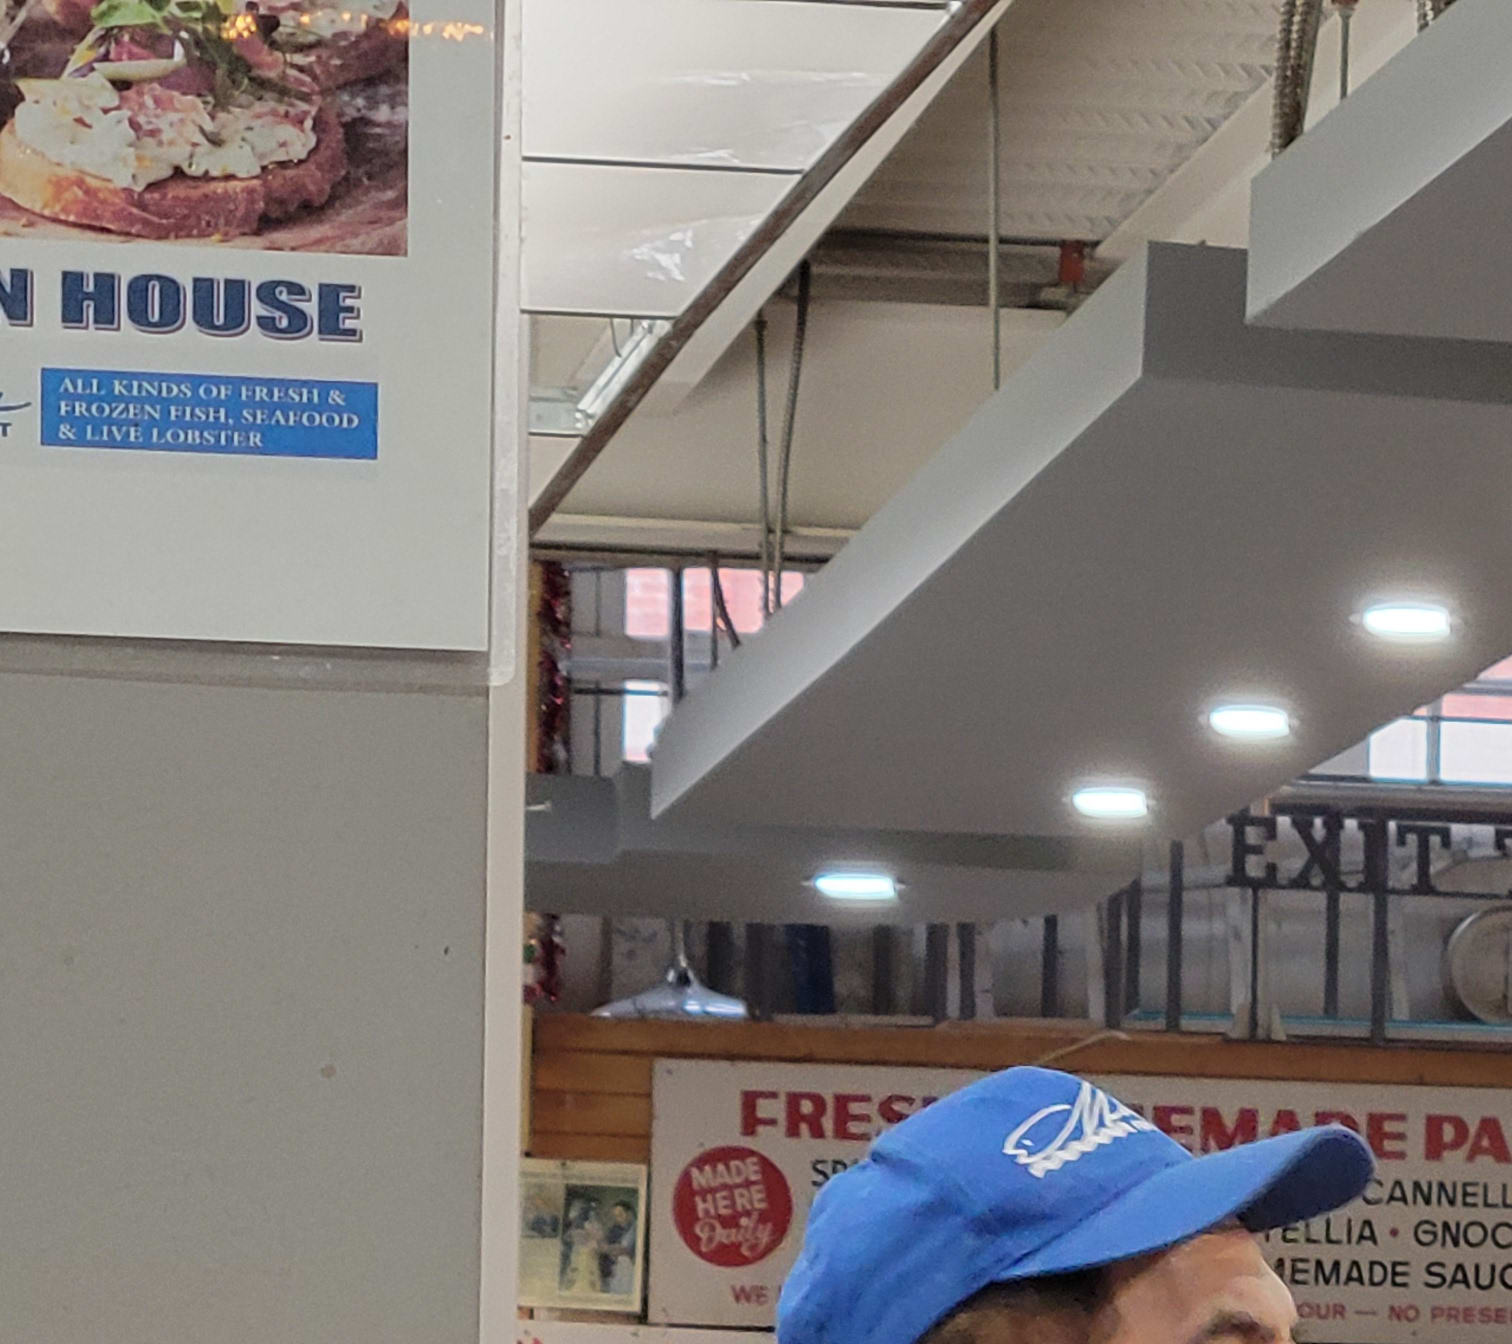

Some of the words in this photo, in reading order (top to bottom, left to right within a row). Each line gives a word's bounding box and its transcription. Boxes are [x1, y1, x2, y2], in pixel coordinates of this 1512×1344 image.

[61, 270, 363, 343] HOUSE
[59, 376, 104, 395] ALL
[113, 379, 192, 399] KINDS
[199, 383, 232, 401] OF
[240, 385, 319, 405] FRESH
[328, 388, 346, 407] &
[59, 401, 161, 421] FROZEN
[169, 406, 234, 426] FISH,
[241, 408, 359, 430] SEAFOOD
[58, 422, 77, 440] &
[85, 424, 144, 443] LIVE
[151, 427, 263, 448] LOBSTER
[1226, 812, 1451, 895] EXIT
[691, 1156, 763, 1191] MADE
[694, 1184, 768, 1219] HERE
[694, 1211, 776, 1258] Daily
[730, 1284, 768, 1306] WE
[1388, 1304, 1420, 1323] NO
